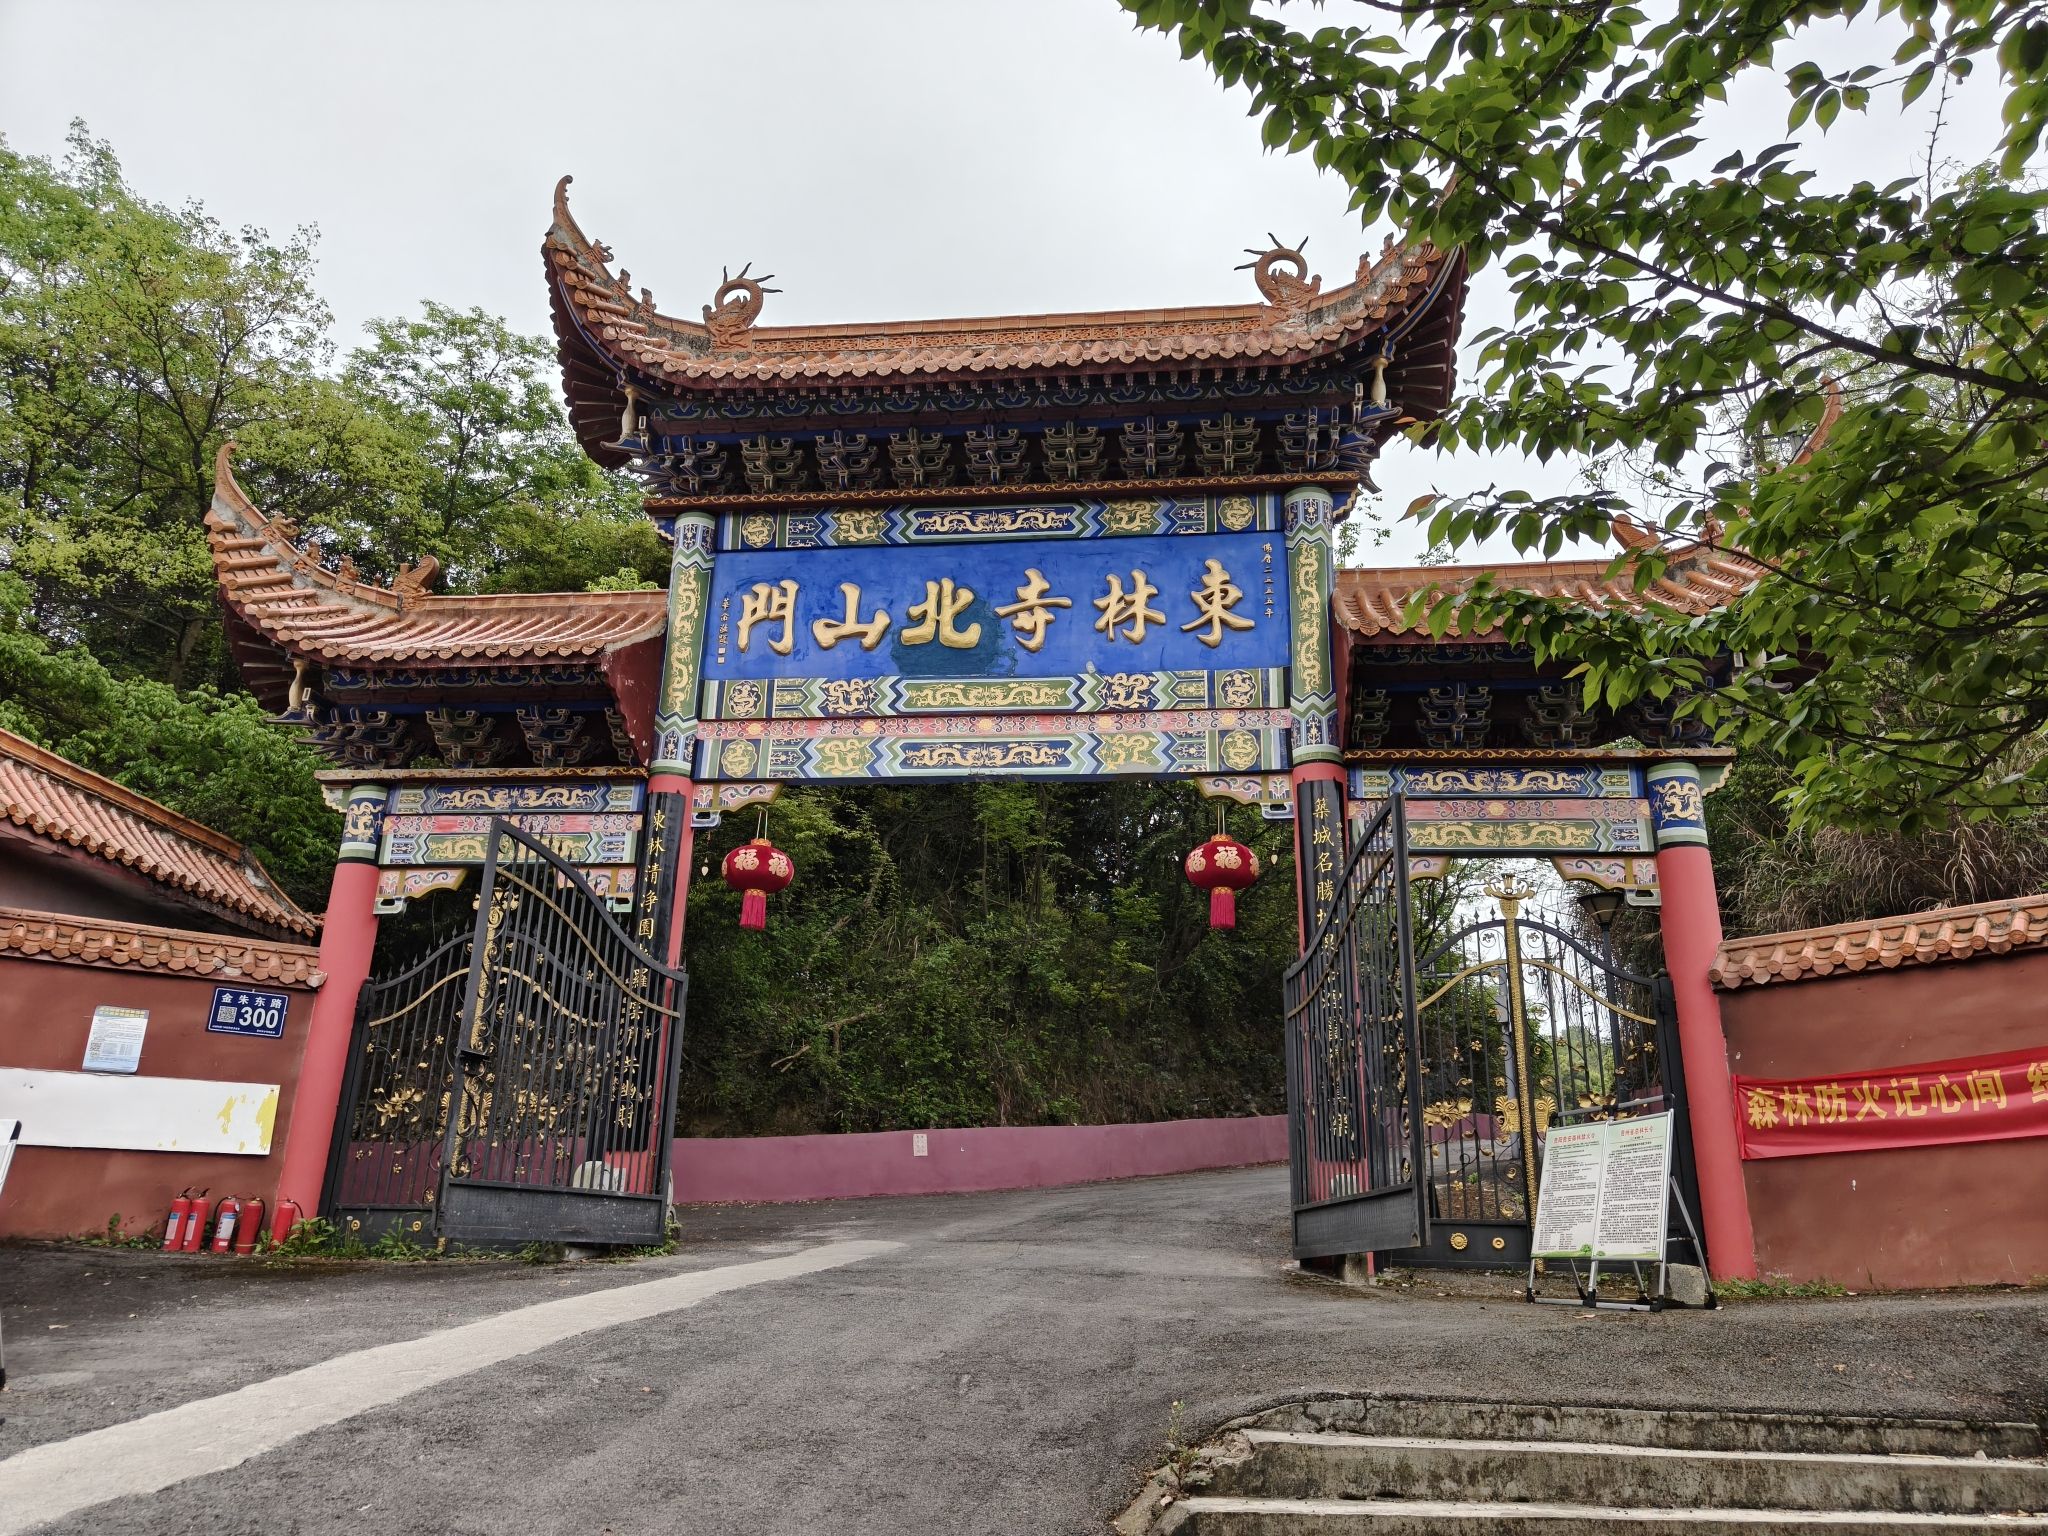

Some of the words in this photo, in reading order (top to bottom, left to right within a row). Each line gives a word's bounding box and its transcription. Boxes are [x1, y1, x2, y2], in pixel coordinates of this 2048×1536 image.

[733, 848, 760, 871] 福
[768, 852, 789, 878] 福
[1214, 845, 1242, 870] 福
[220, 992, 283, 1010] 金朱东路
[238, 1006, 279, 1029] 300
[1747, 1068, 2008, 1130] 森林防火记心间
